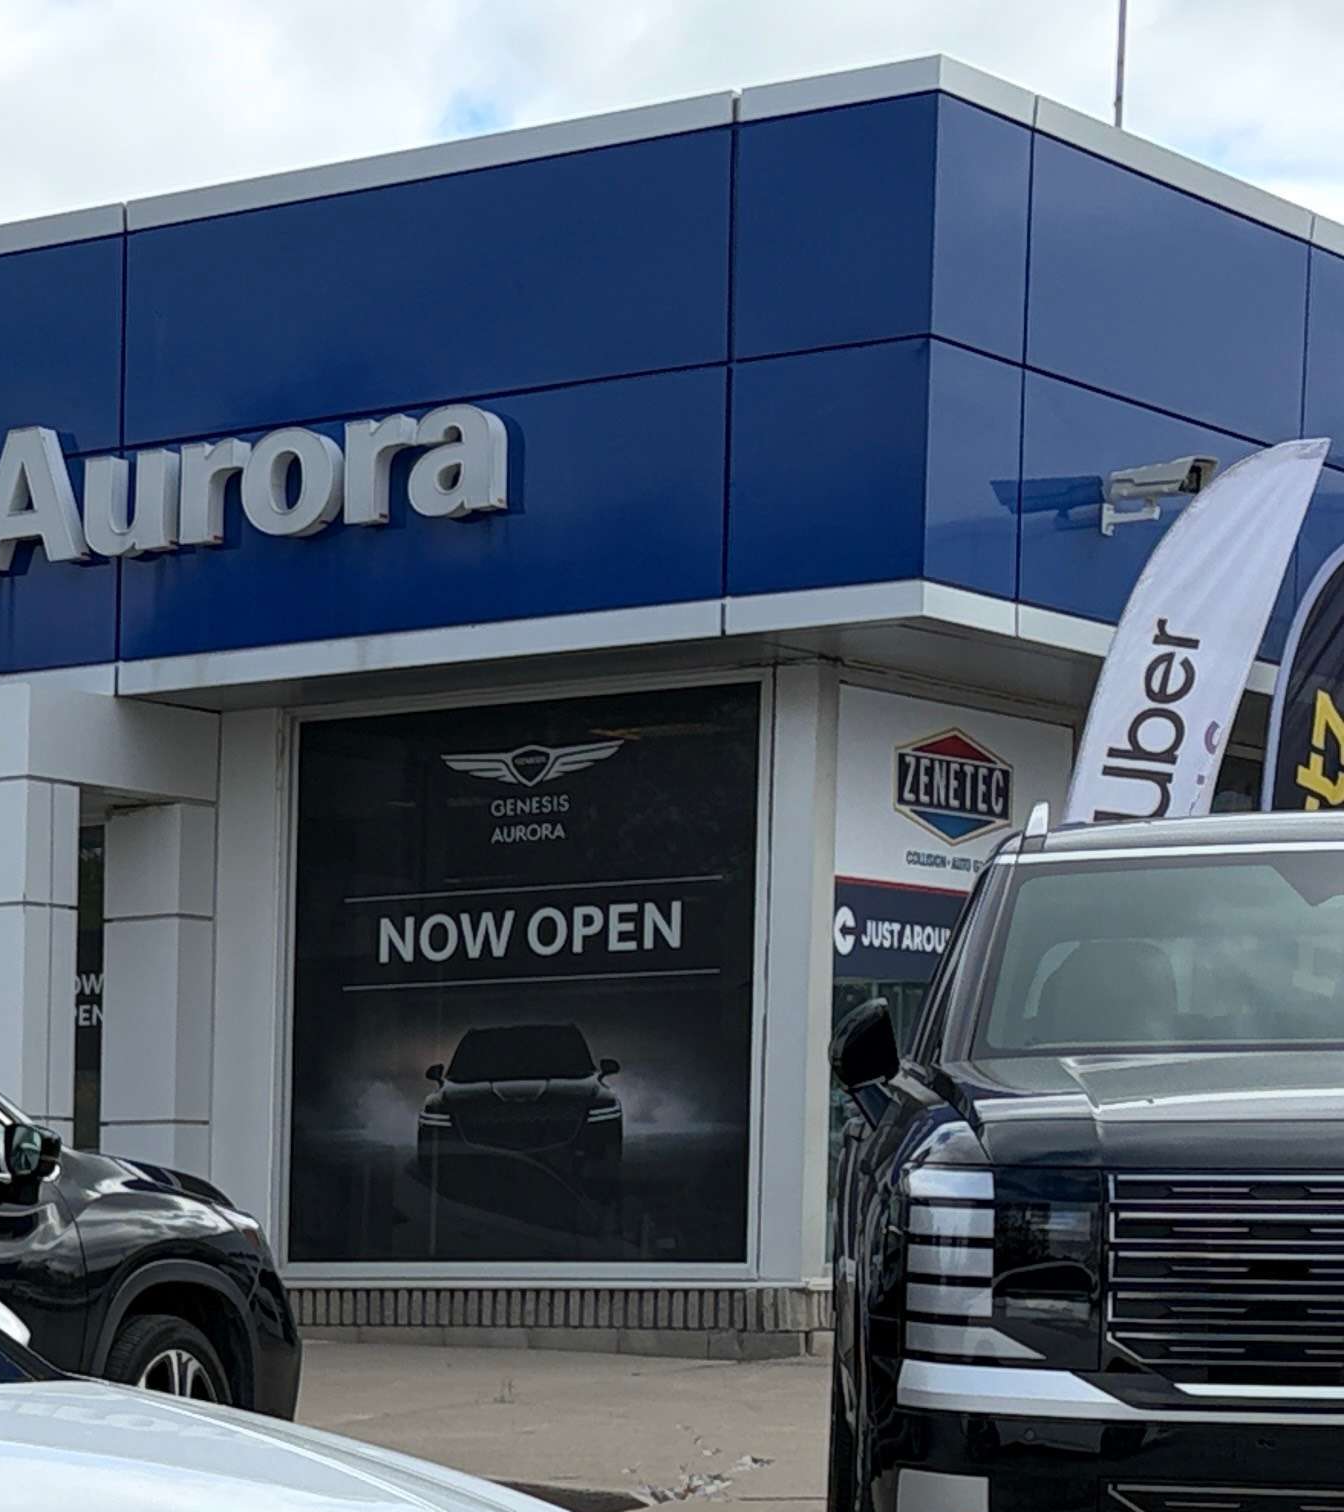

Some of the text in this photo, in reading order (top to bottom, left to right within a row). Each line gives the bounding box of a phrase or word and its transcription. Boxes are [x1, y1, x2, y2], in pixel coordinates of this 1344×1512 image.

[902, 755, 1005, 814] ZENETEC
[491, 795, 570, 817] GENESIS
[491, 823, 566, 844] AURORA
[378, 901, 682, 964] NOW OPEN
[861, 919, 902, 949] JUST
